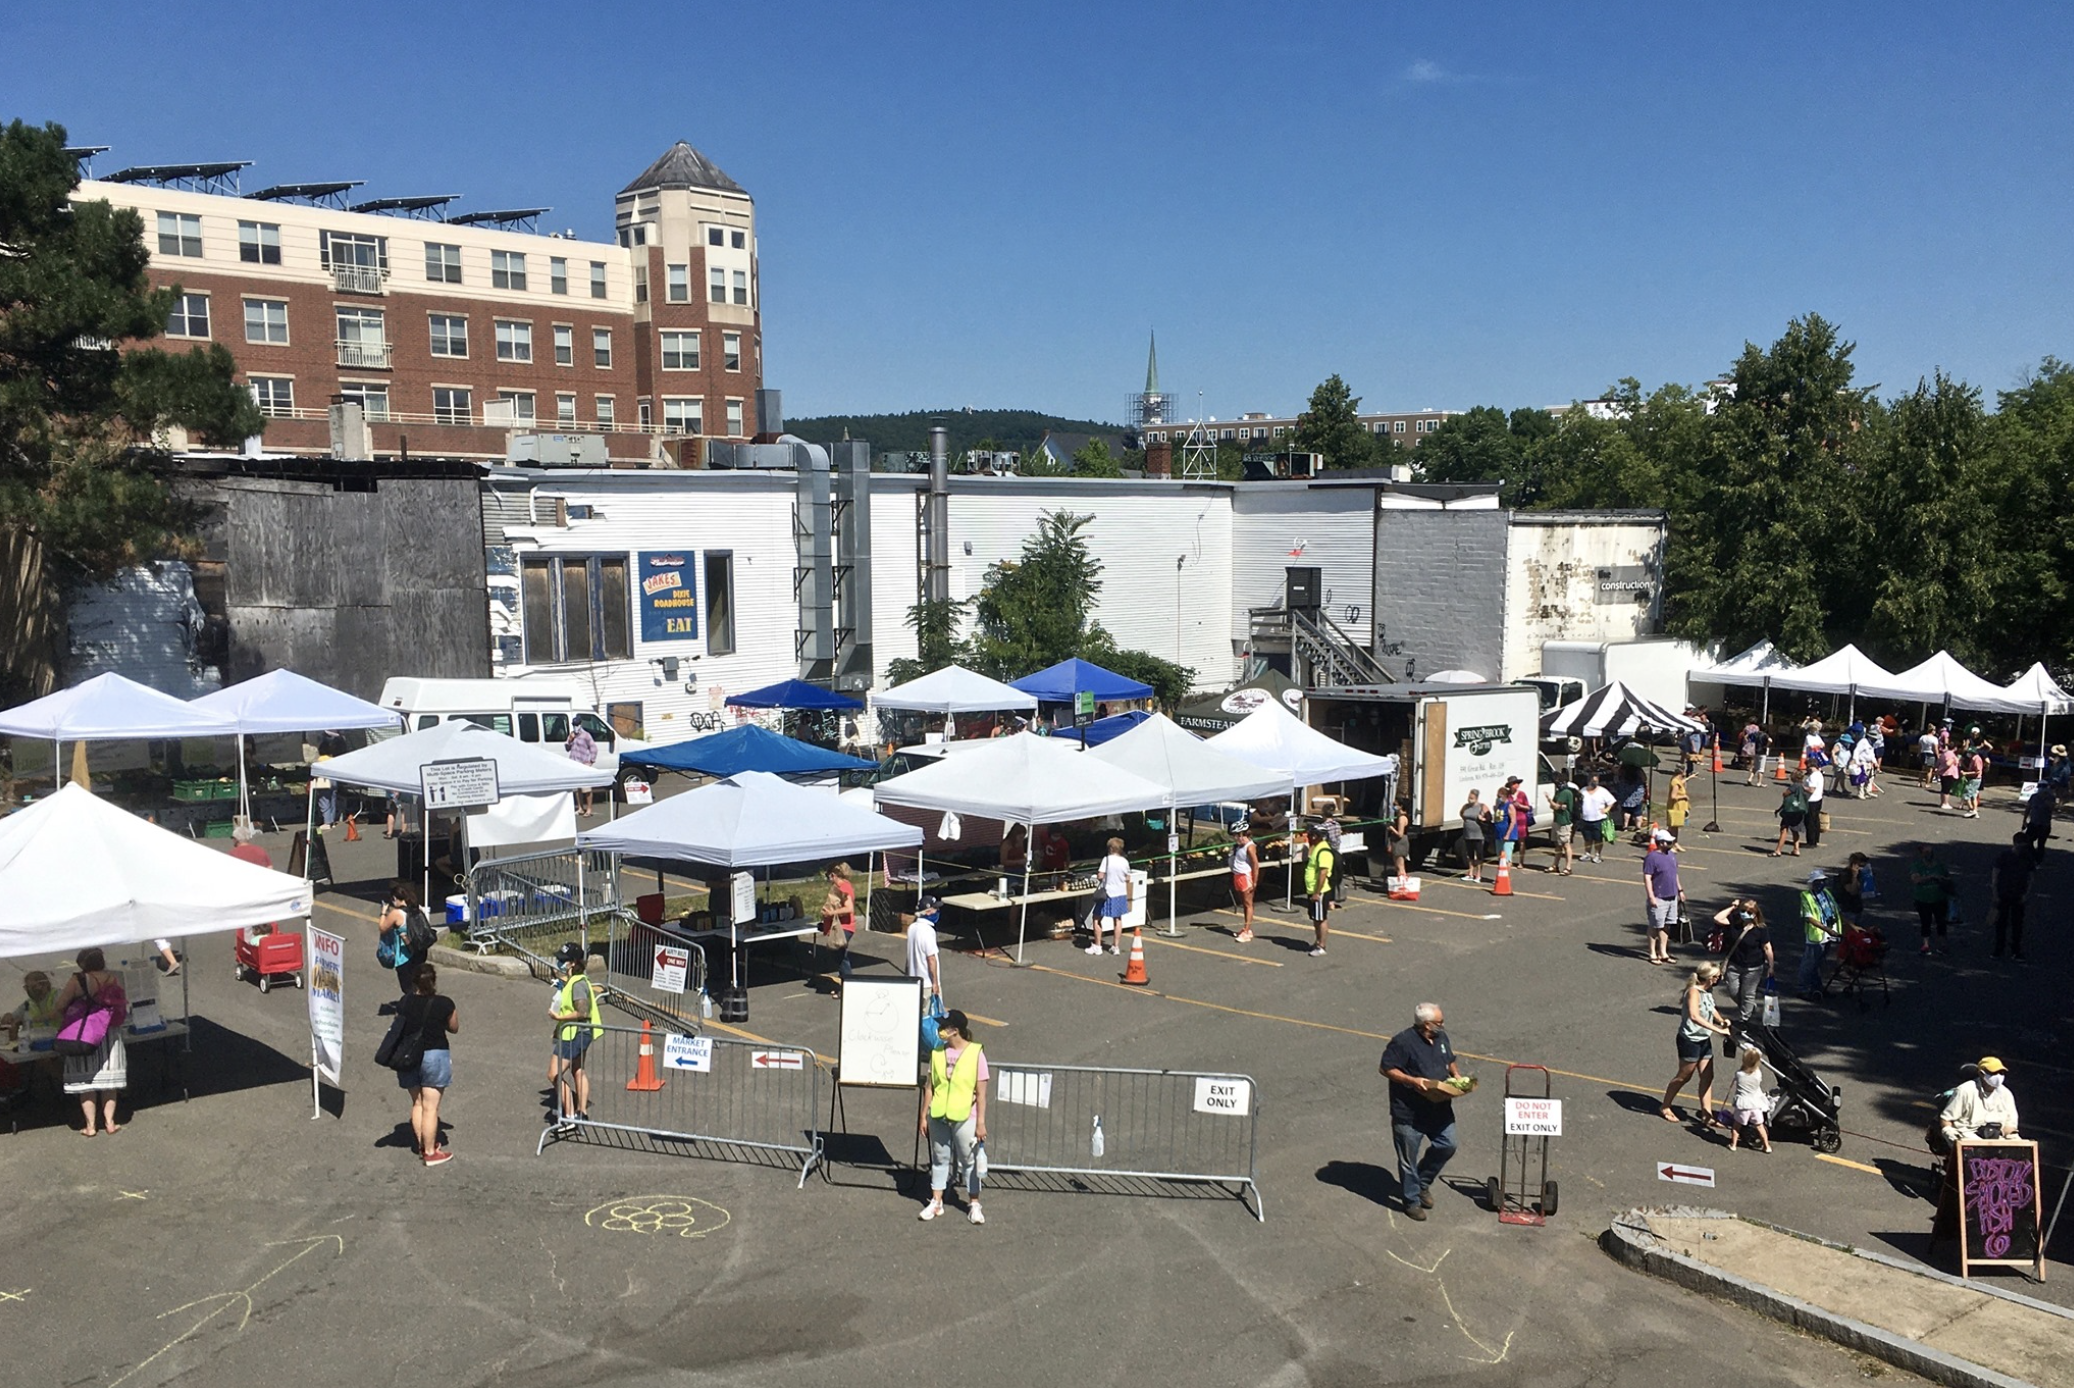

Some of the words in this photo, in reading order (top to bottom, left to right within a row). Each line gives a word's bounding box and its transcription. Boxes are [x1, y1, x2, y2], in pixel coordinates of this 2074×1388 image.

[1601, 580, 1650, 590] construction
[672, 589, 690, 599] DIXIE
[653, 598, 694, 608] ROADHOUSE
[666, 616, 693, 633] EAT
[1180, 717, 1236, 730] FARMSTEAD
[1461, 730, 1483, 740] SPRING
[1485, 727, 1505, 738] BROOK
[314, 933, 339, 956] INFO
[667, 957, 676, 965] ONE
[672, 1036, 706, 1047] MARKET
[666, 1045, 709, 1057] ENTRANCE
[1210, 1085, 1236, 1096] EXIT
[1206, 1096, 1237, 1108] ONLY
[1515, 1101, 1530, 1110] DO
[1532, 1102, 1552, 1110] NOT
[1518, 1111, 1548, 1120] ENTER
[1510, 1123, 1531, 1131] EXIT
[1532, 1123, 1558, 1132] ONLY
